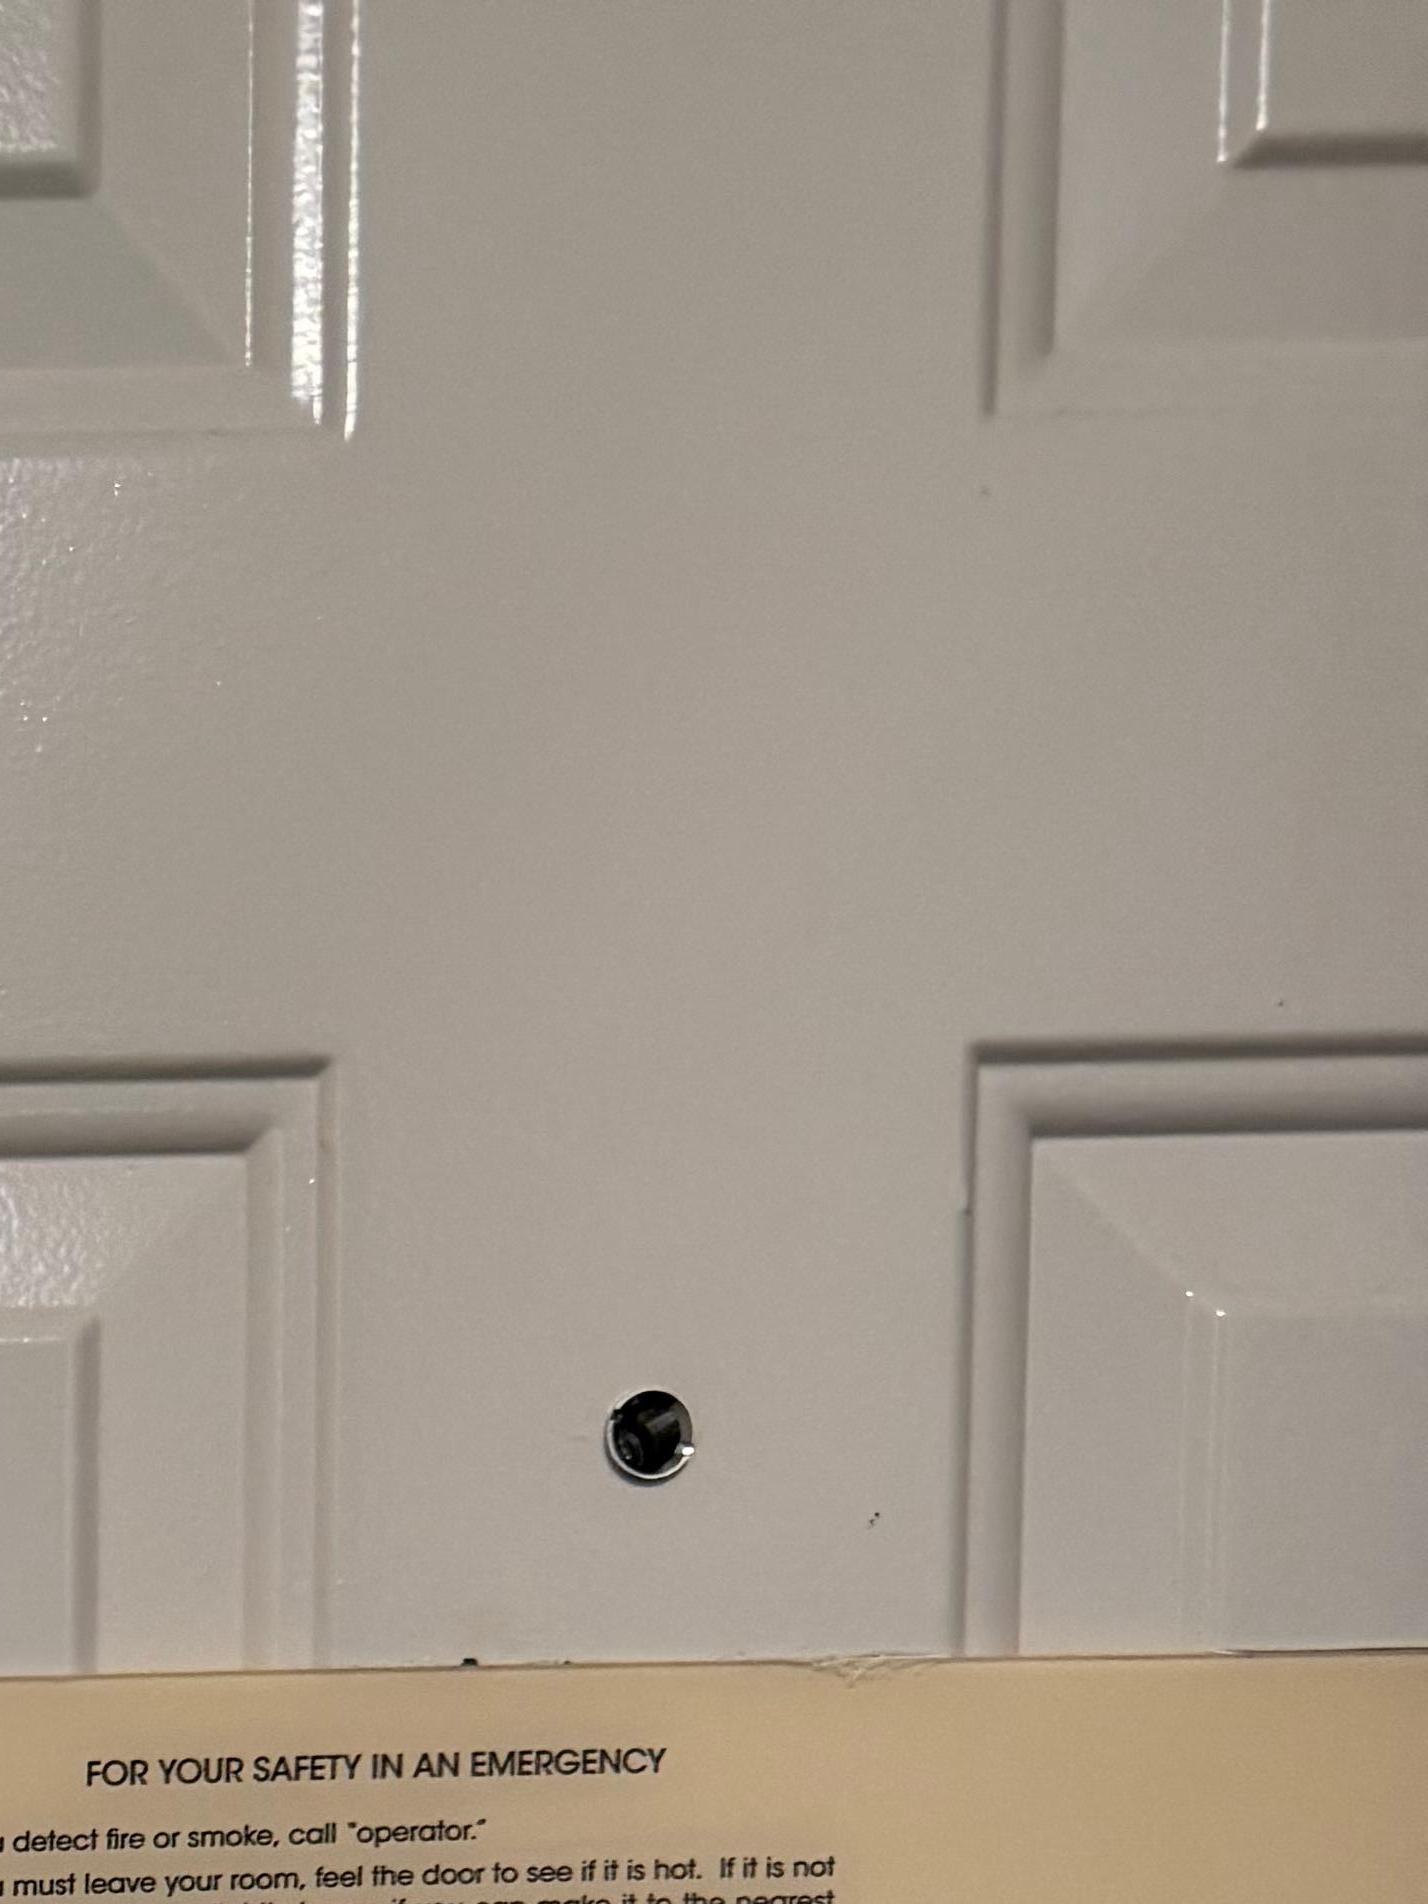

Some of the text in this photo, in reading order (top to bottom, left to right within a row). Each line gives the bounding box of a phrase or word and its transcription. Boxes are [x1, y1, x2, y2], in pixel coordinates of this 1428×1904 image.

[86, 1747, 667, 1787] FOR YOUR SAFETY IN AN EMERGENCY
[12, 1828, 100, 1853] detect
[106, 1828, 146, 1850] fire
[153, 1831, 182, 1849] or
[187, 1824, 280, 1848] smoke,
[288, 1822, 337, 1845] call
